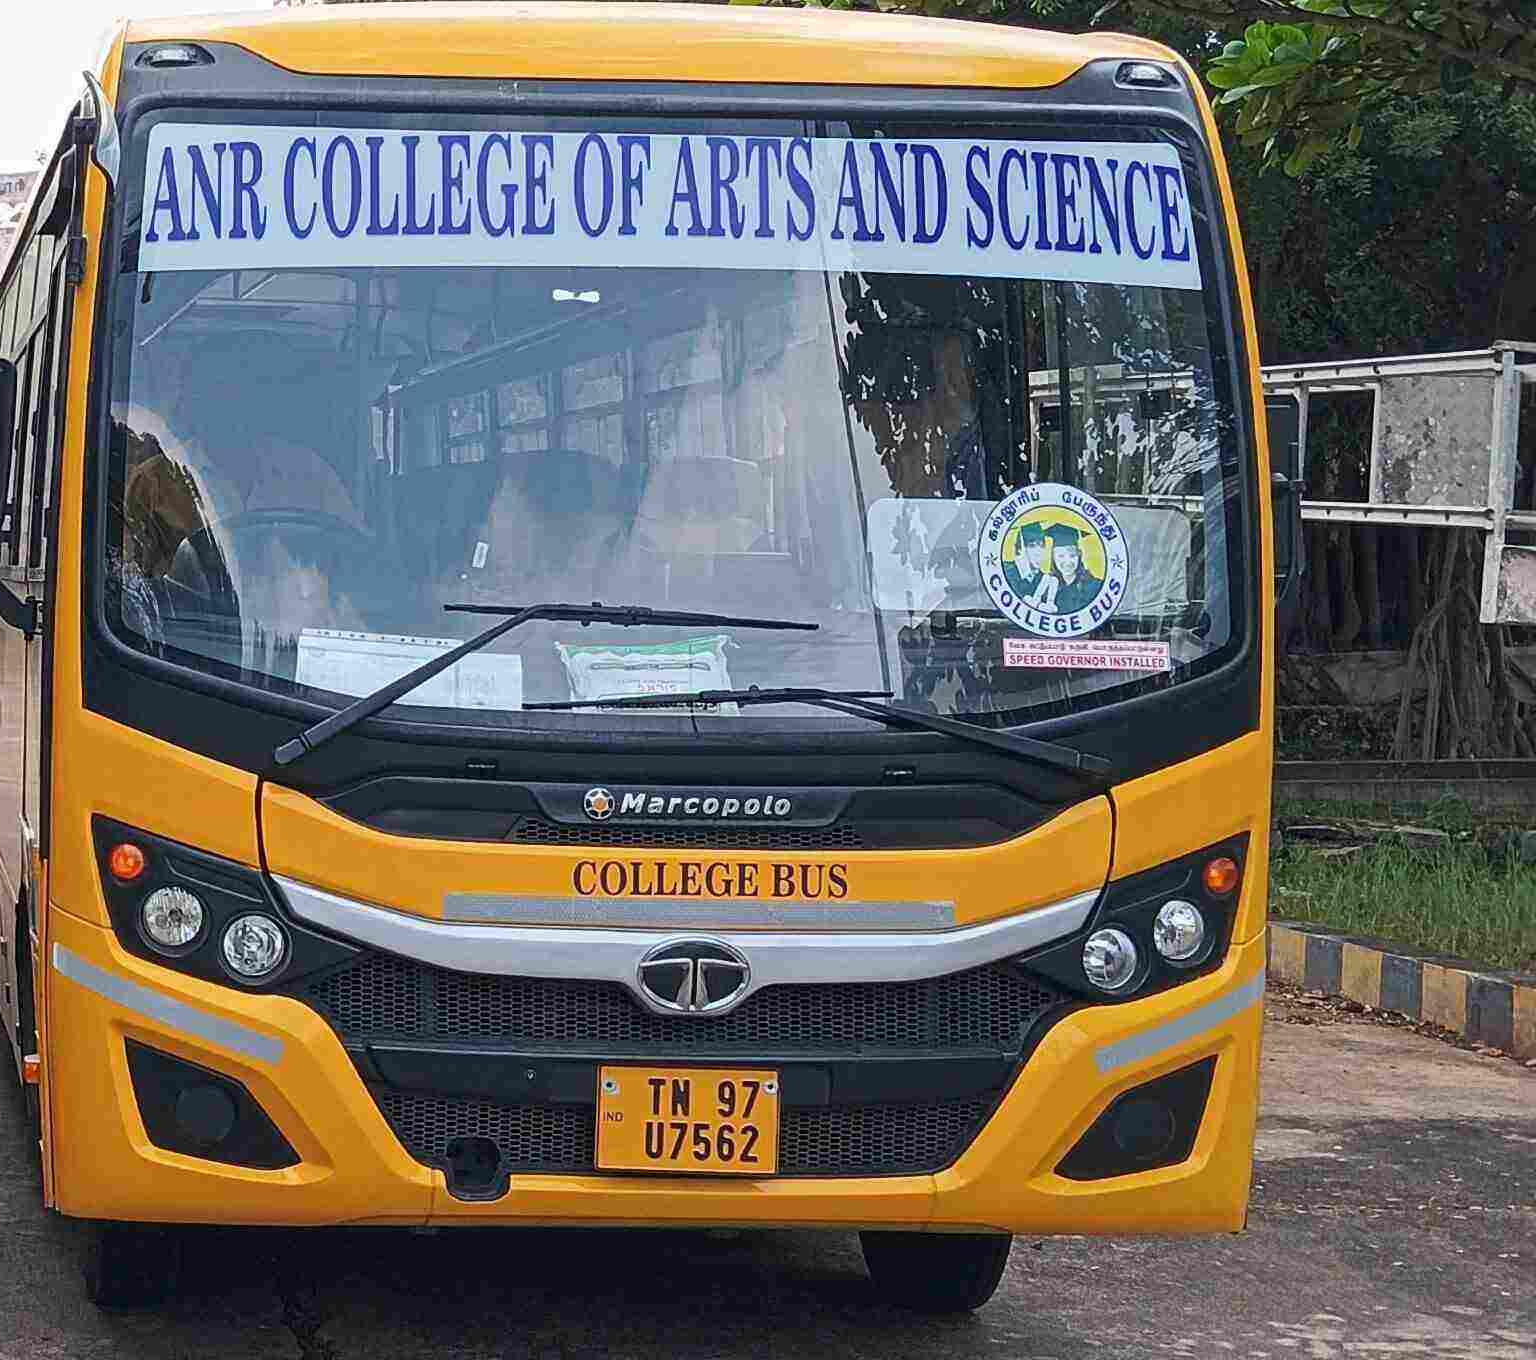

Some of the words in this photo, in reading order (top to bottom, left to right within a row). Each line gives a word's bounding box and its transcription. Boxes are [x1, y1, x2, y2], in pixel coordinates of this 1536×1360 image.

[145, 141, 266, 242] ANR
[283, 133, 556, 239] COLLEGE
[574, 133, 651, 237] OF
[664, 136, 816, 242] ARTS
[830, 140, 948, 244] AND
[966, 145, 1191, 262] SCIENCE
[1063, 491, 1117, 542] பேருந்து
[989, 574, 1082, 633] COLLEGE
[1090, 578, 1121, 623] BUS
[1009, 655, 1044, 665] SPEED
[1048, 655, 1106, 667] GOVERNOR
[1109, 656, 1165, 668] INSTALLED
[620, 792, 792, 817] Marcopolo
[573, 861, 759, 897] COLLEGE
[771, 863, 848, 898] BUS
[602, 1112, 624, 1122] IND
[648, 1078, 690, 1117] TN
[717, 1080, 760, 1118] 97
[645, 1122, 760, 1163] U7562
